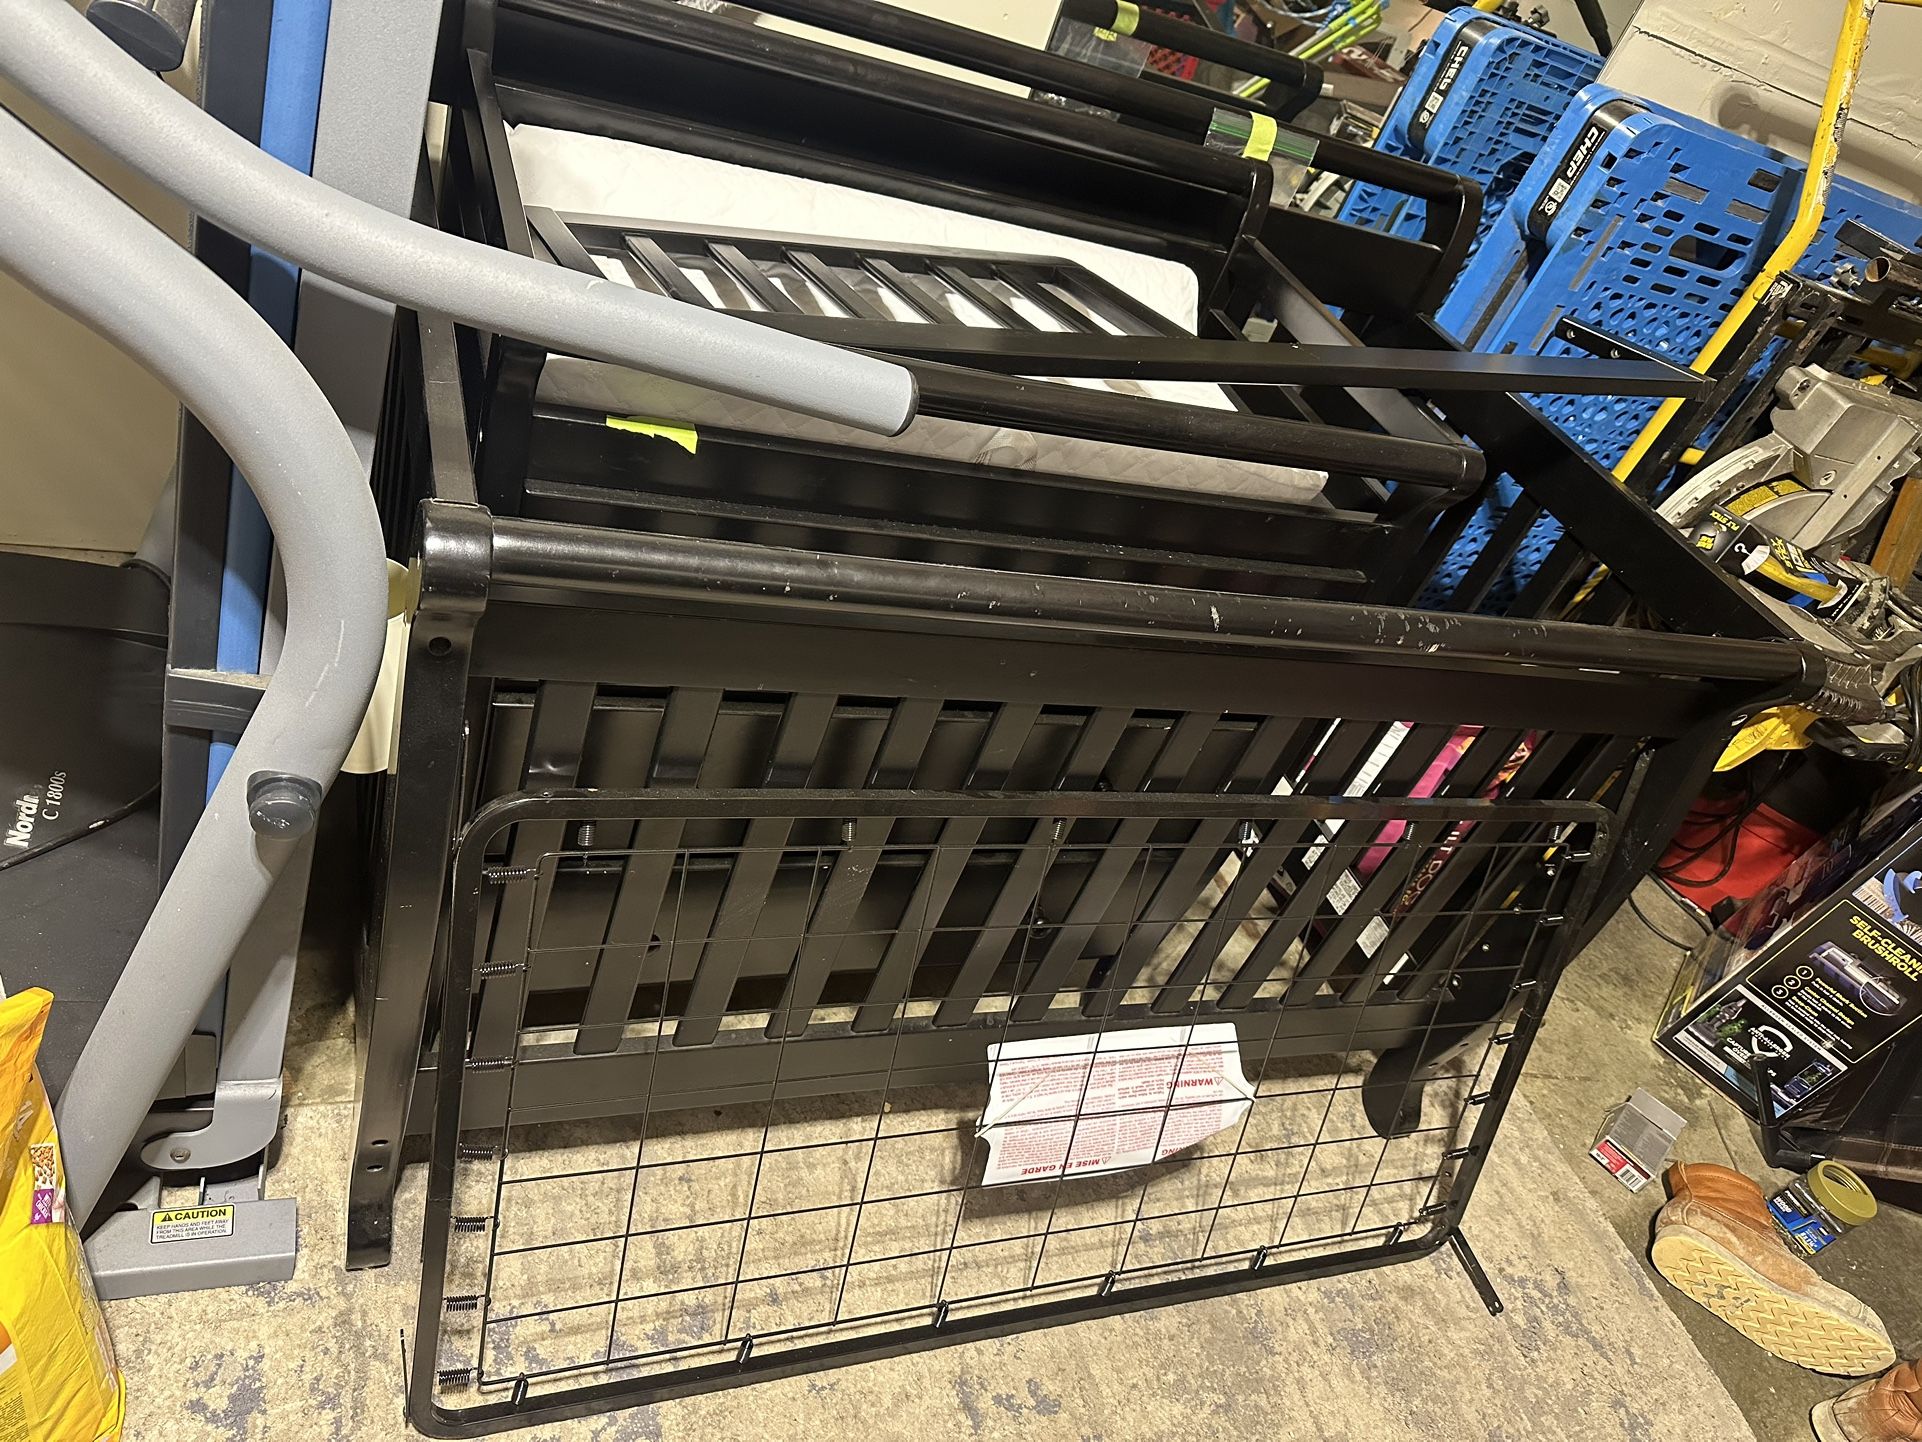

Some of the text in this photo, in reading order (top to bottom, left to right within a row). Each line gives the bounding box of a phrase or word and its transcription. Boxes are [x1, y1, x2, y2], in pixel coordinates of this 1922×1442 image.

[1566, 126, 1600, 178] CHEP
[1726, 520, 1740, 531] FLY
[42, 770, 67, 821] C 1800s
[1852, 929, 1919, 982] BRUSHROLL
[1750, 1027, 1791, 1059] ANTI-ALLERGEN
[1166, 1077, 1214, 1089] WARNING
[1075, 1158, 1100, 1167] MISE
[1021, 1165, 1056, 1175] GARDE
[174, 1208, 227, 1221] CAUTION
